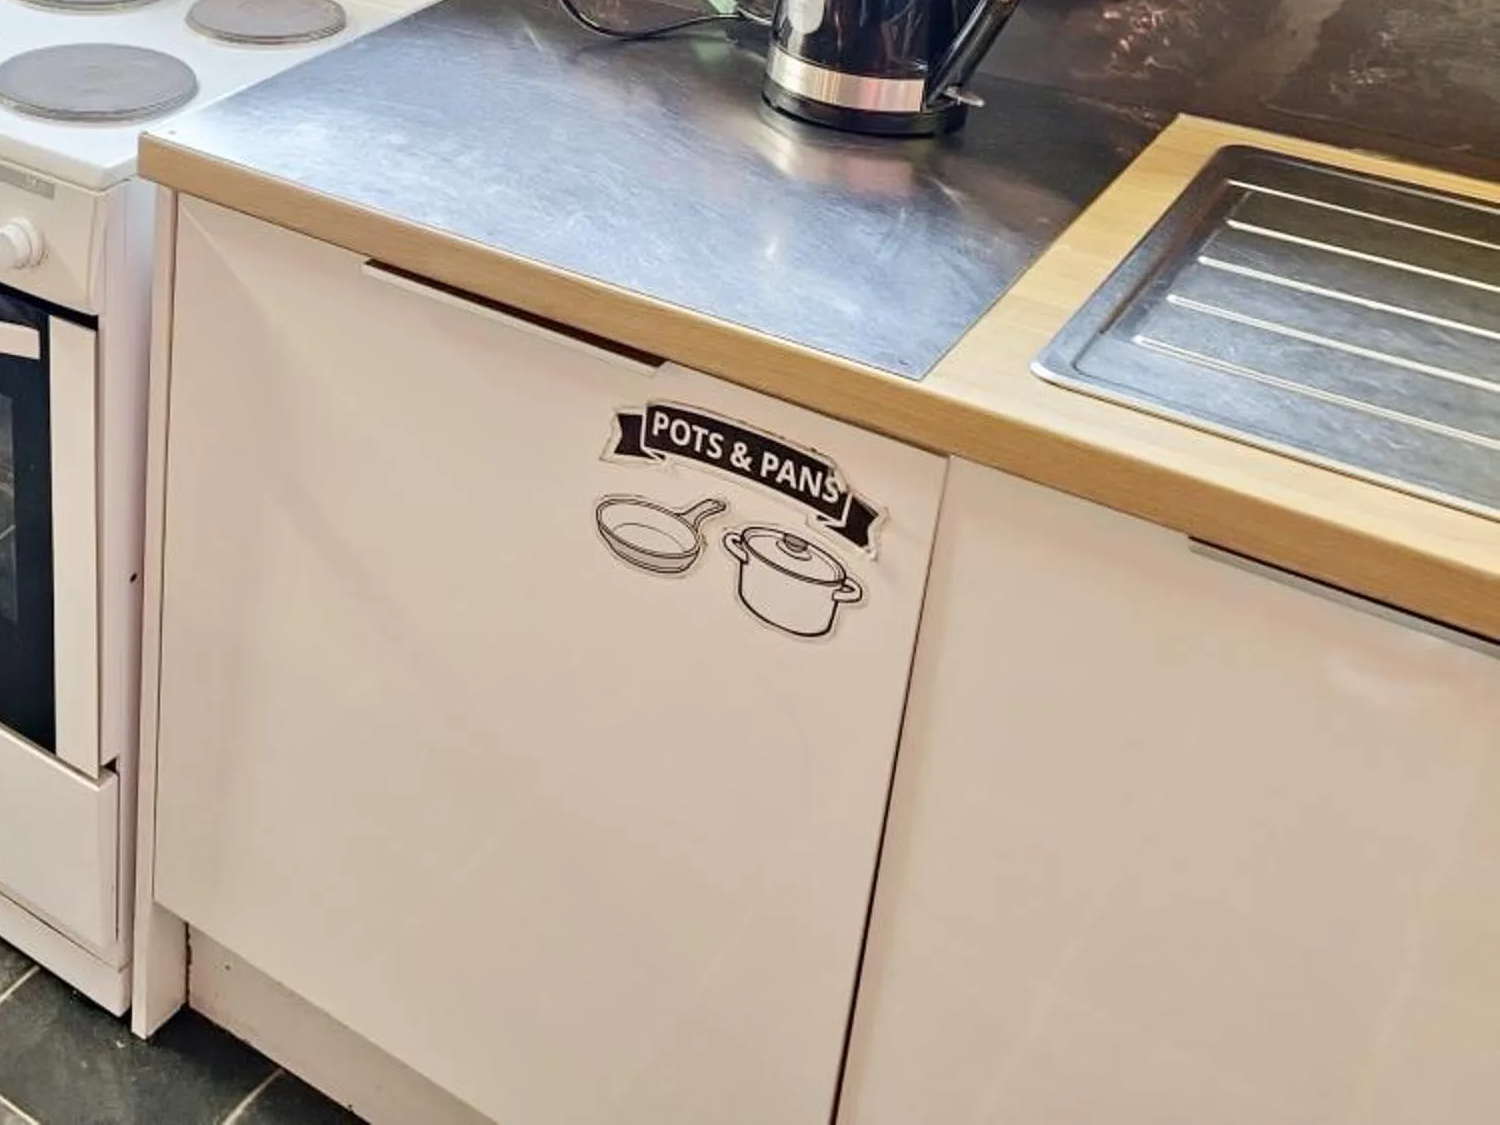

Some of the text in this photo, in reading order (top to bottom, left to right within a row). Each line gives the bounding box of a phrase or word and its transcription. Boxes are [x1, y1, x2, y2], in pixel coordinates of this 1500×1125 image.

[652, 411, 841, 505] POTS & PANS
